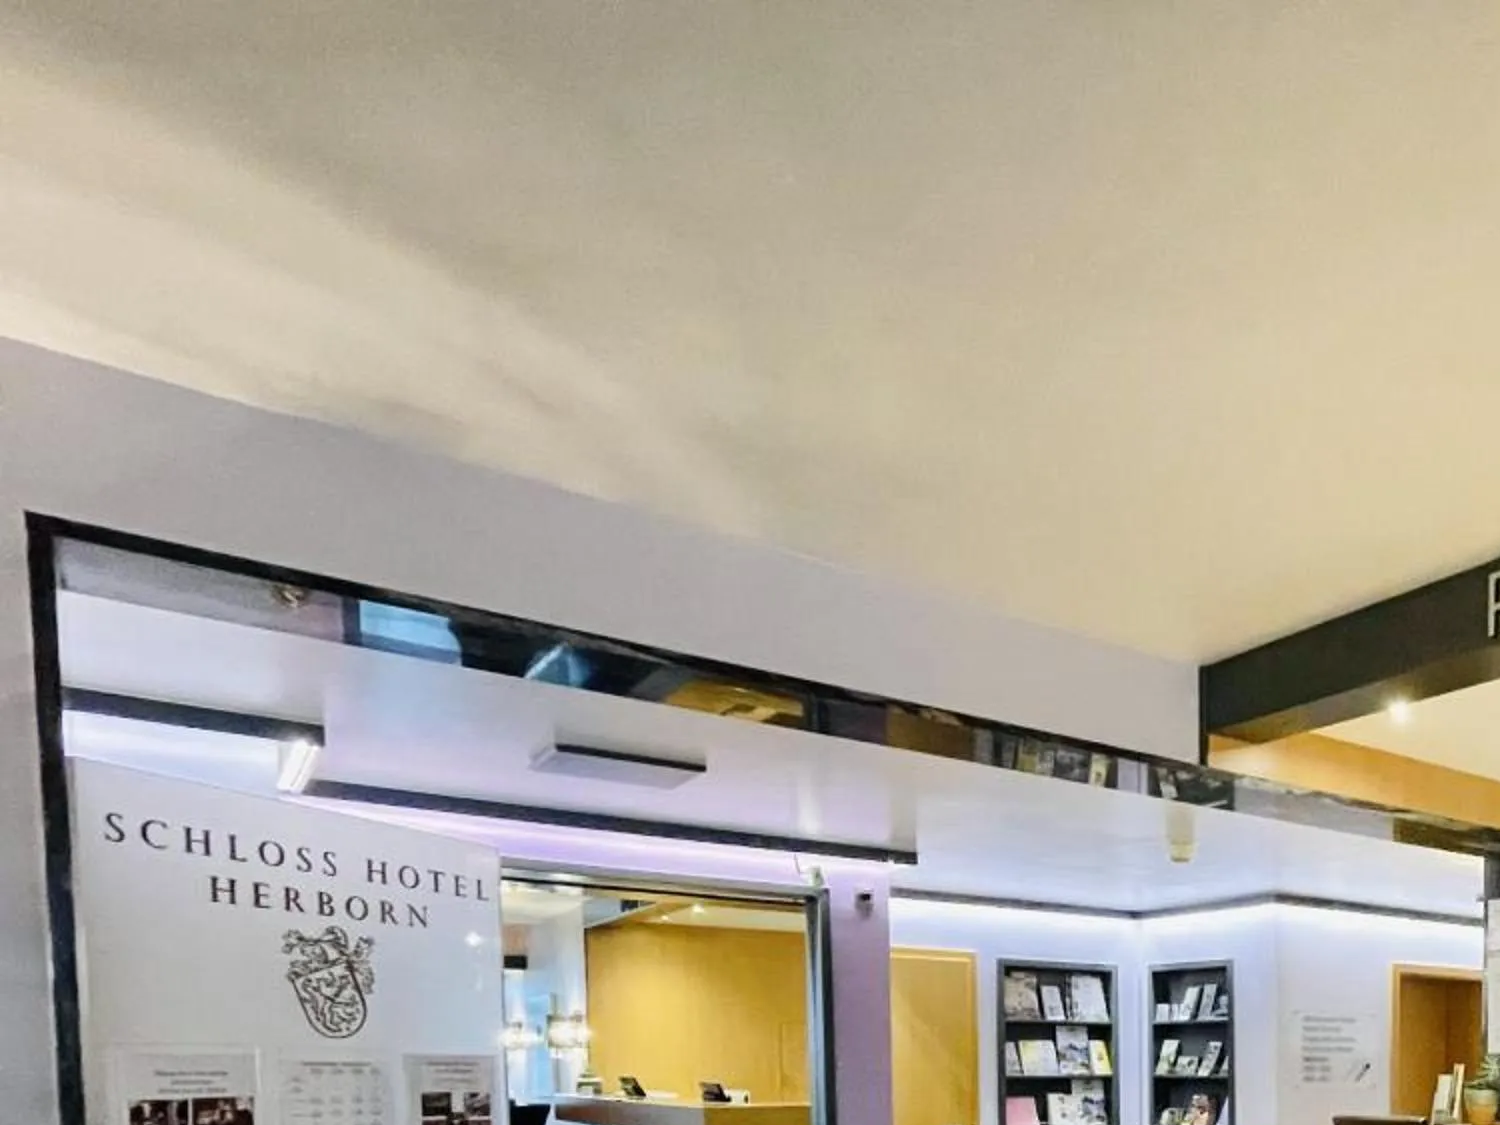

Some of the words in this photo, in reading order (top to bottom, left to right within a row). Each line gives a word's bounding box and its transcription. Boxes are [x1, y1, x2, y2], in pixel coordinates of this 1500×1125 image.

[104, 813, 338, 877] SCHLOSS
[366, 859, 491, 902] HOTEL
[210, 876, 431, 929] HERBORN
